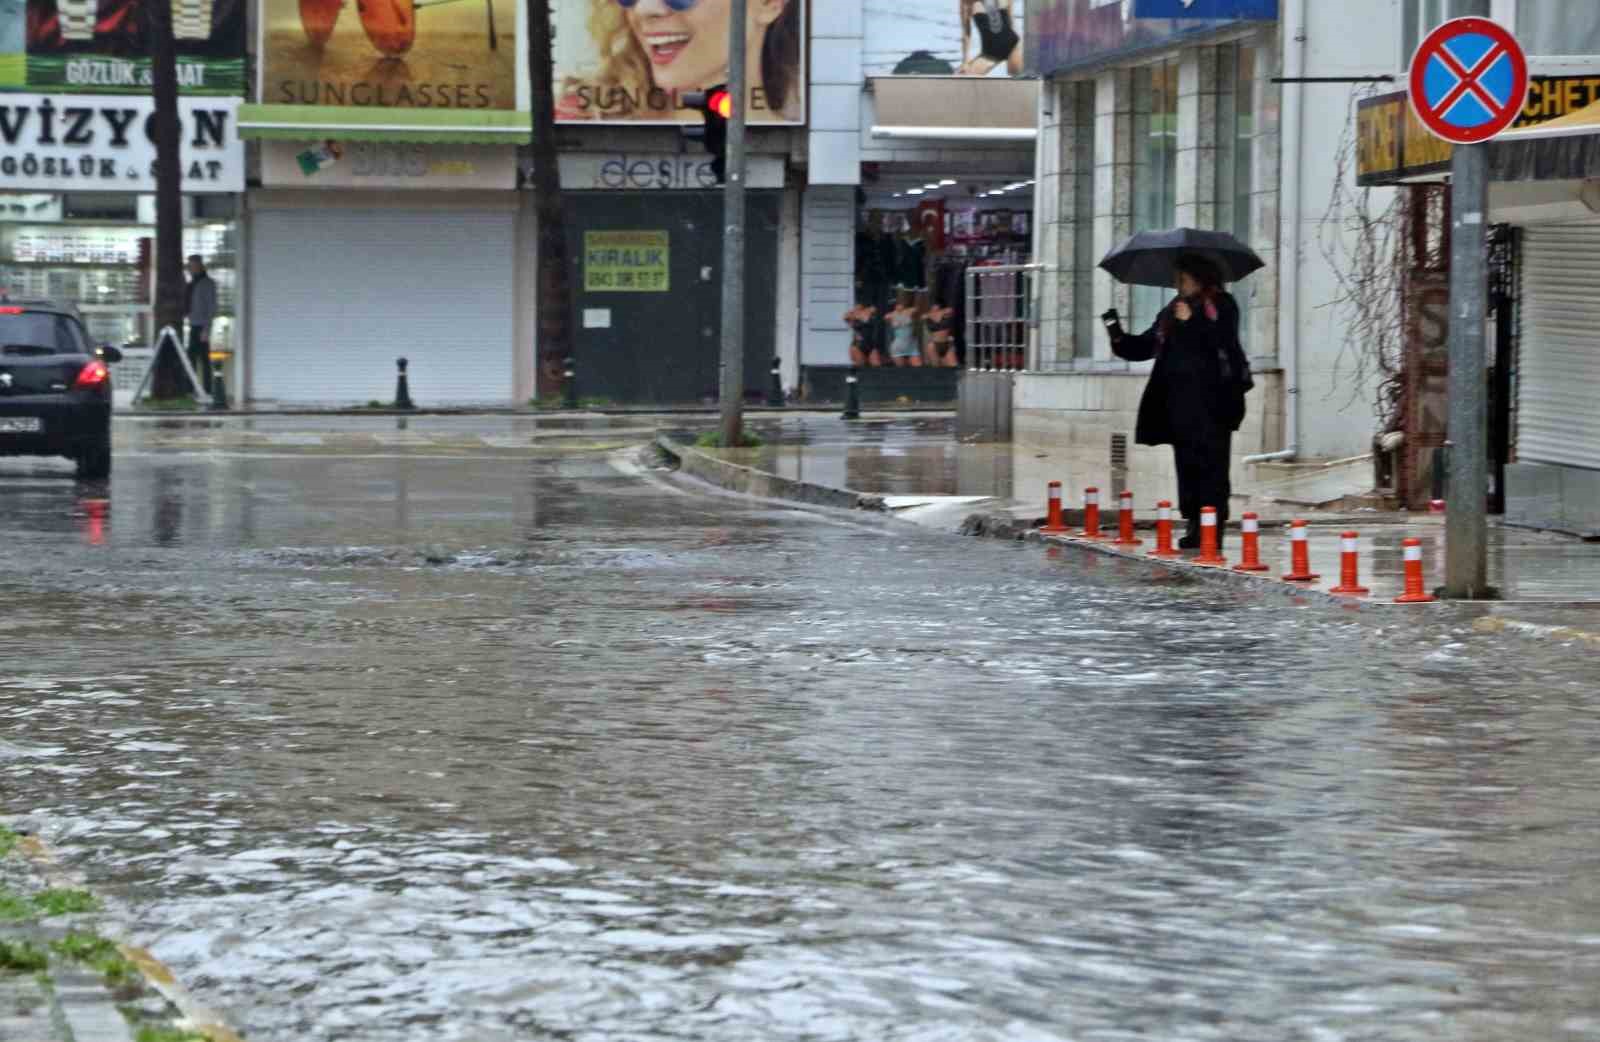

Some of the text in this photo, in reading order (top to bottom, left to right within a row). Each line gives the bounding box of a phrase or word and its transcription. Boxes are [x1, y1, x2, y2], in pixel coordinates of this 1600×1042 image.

[279, 80, 490, 109] SUNGLASSES
[577, 85, 767, 111] SUNGLE
[602, 154, 718, 188] desire
